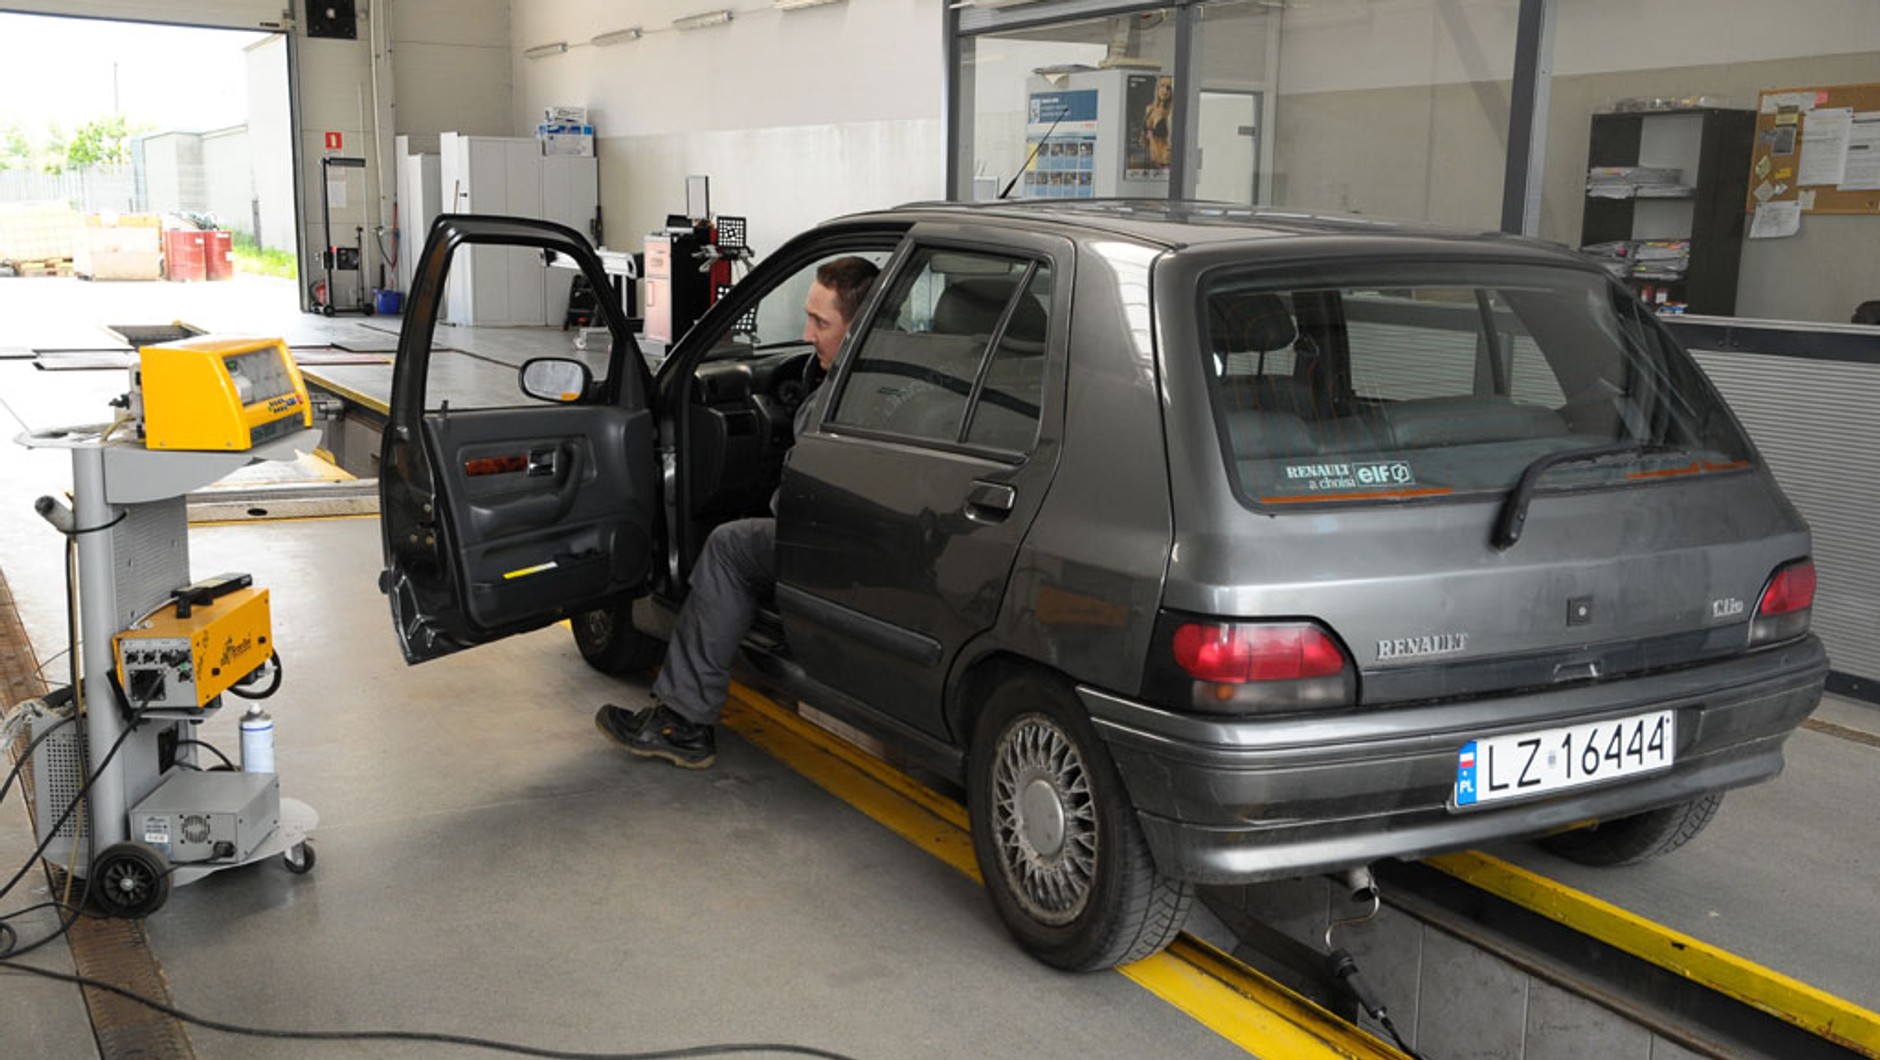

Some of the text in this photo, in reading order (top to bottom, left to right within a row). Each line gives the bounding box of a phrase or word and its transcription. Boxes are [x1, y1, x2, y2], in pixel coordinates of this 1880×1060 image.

[1286, 464, 1350, 479] RENAULT
[1358, 466, 1390, 483] elf
[1308, 475, 1357, 490] a choisi
[1713, 597, 1744, 617] Clio
[1377, 633, 1469, 660] RENAULT
[1488, 714, 1665, 792] LZ 16444
[1458, 779, 1474, 794] PL
